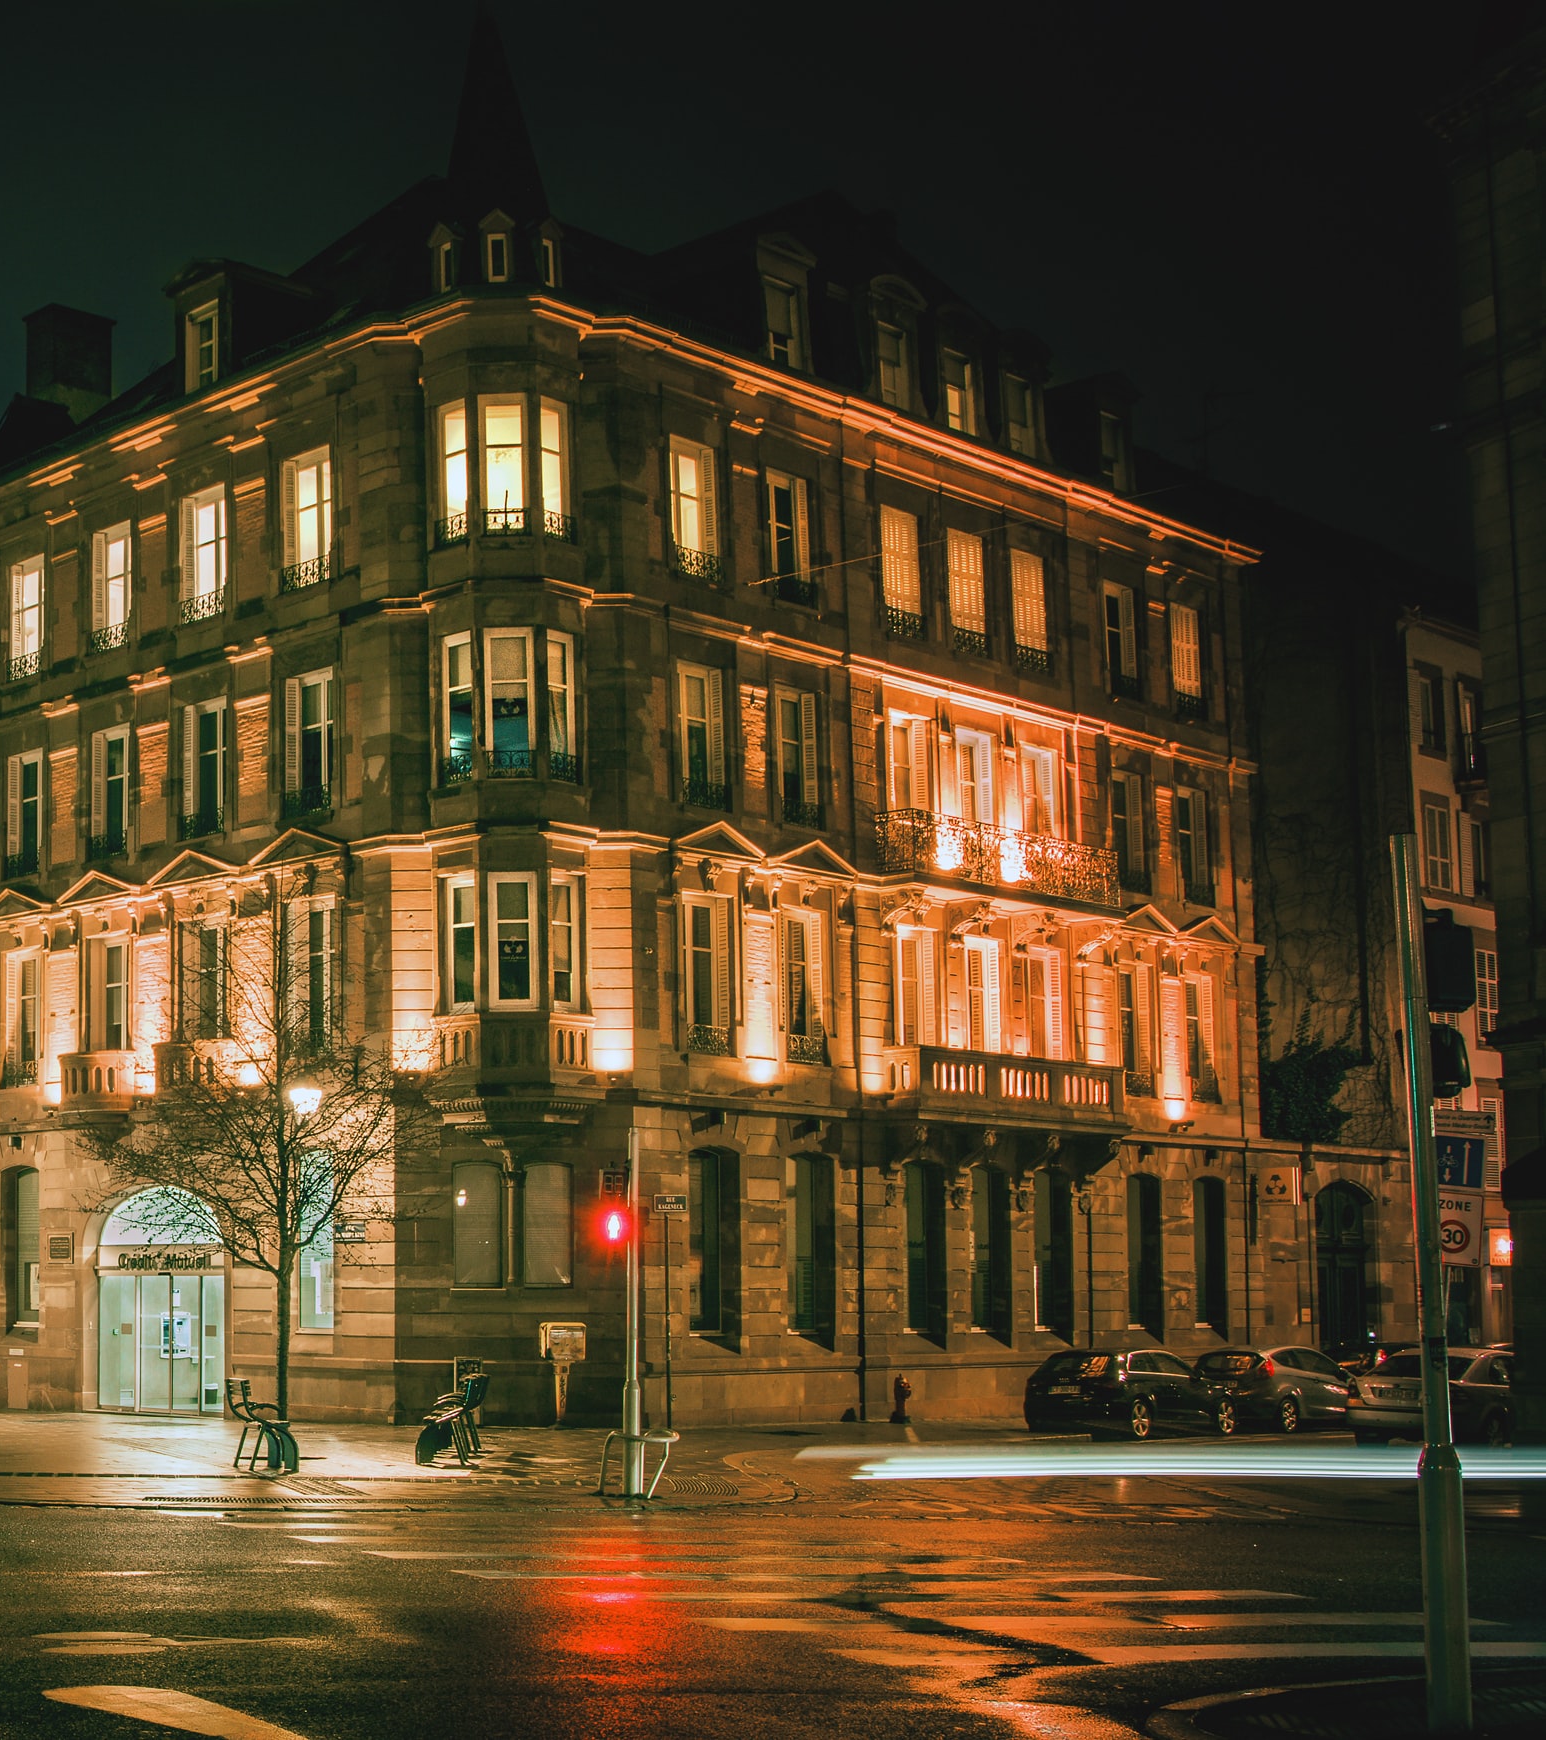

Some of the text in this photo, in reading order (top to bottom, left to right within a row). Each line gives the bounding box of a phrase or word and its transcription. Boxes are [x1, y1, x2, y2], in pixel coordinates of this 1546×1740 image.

[1439, 1199, 1472, 1212] ZONE
[1441, 1228, 1465, 1245] 30
[118, 1252, 207, 1269] Crédit Mutuel
